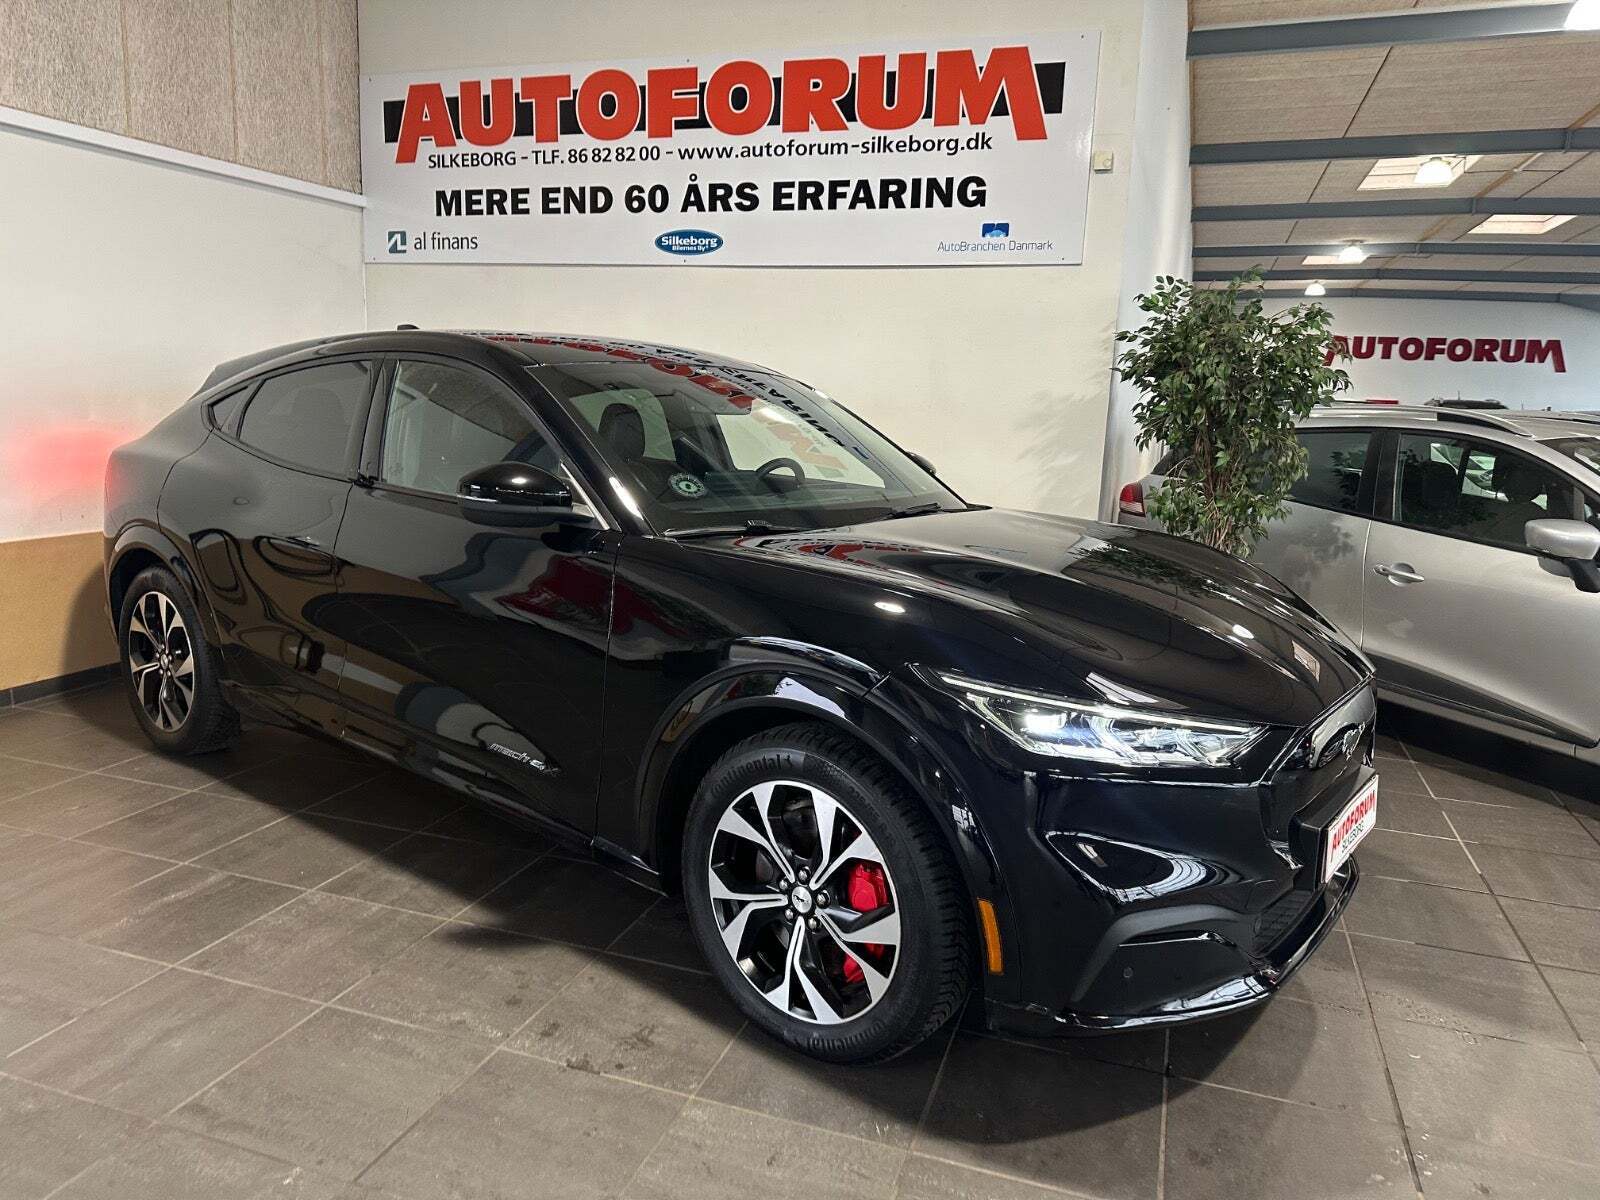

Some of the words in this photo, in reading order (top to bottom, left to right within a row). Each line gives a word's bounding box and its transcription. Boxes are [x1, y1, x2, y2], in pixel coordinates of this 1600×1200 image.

[395, 45, 1048, 164] AUTOFORUM
[427, 150, 516, 169] SILKEBORG
[532, 149, 564, 166] TLF.
[677, 132, 993, 160] www.autoforum-silkeborg.dk
[435, 187, 531, 217] MERE
[540, 185, 614, 216] END
[624, 183, 670, 214] 60
[680, 173, 760, 212] ÅRS
[772, 175, 988, 212] ERFARING
[413, 231, 427, 250] al
[431, 231, 479, 250] finans
[661, 235, 718, 248] Silkeborg
[937, 240, 1006, 252] AutoBranchen
[1008, 239, 1053, 252] Danmark
[1322, 335, 1567, 373] AUTOFORUM
[1330, 789, 1377, 863] AUTOFORUM
